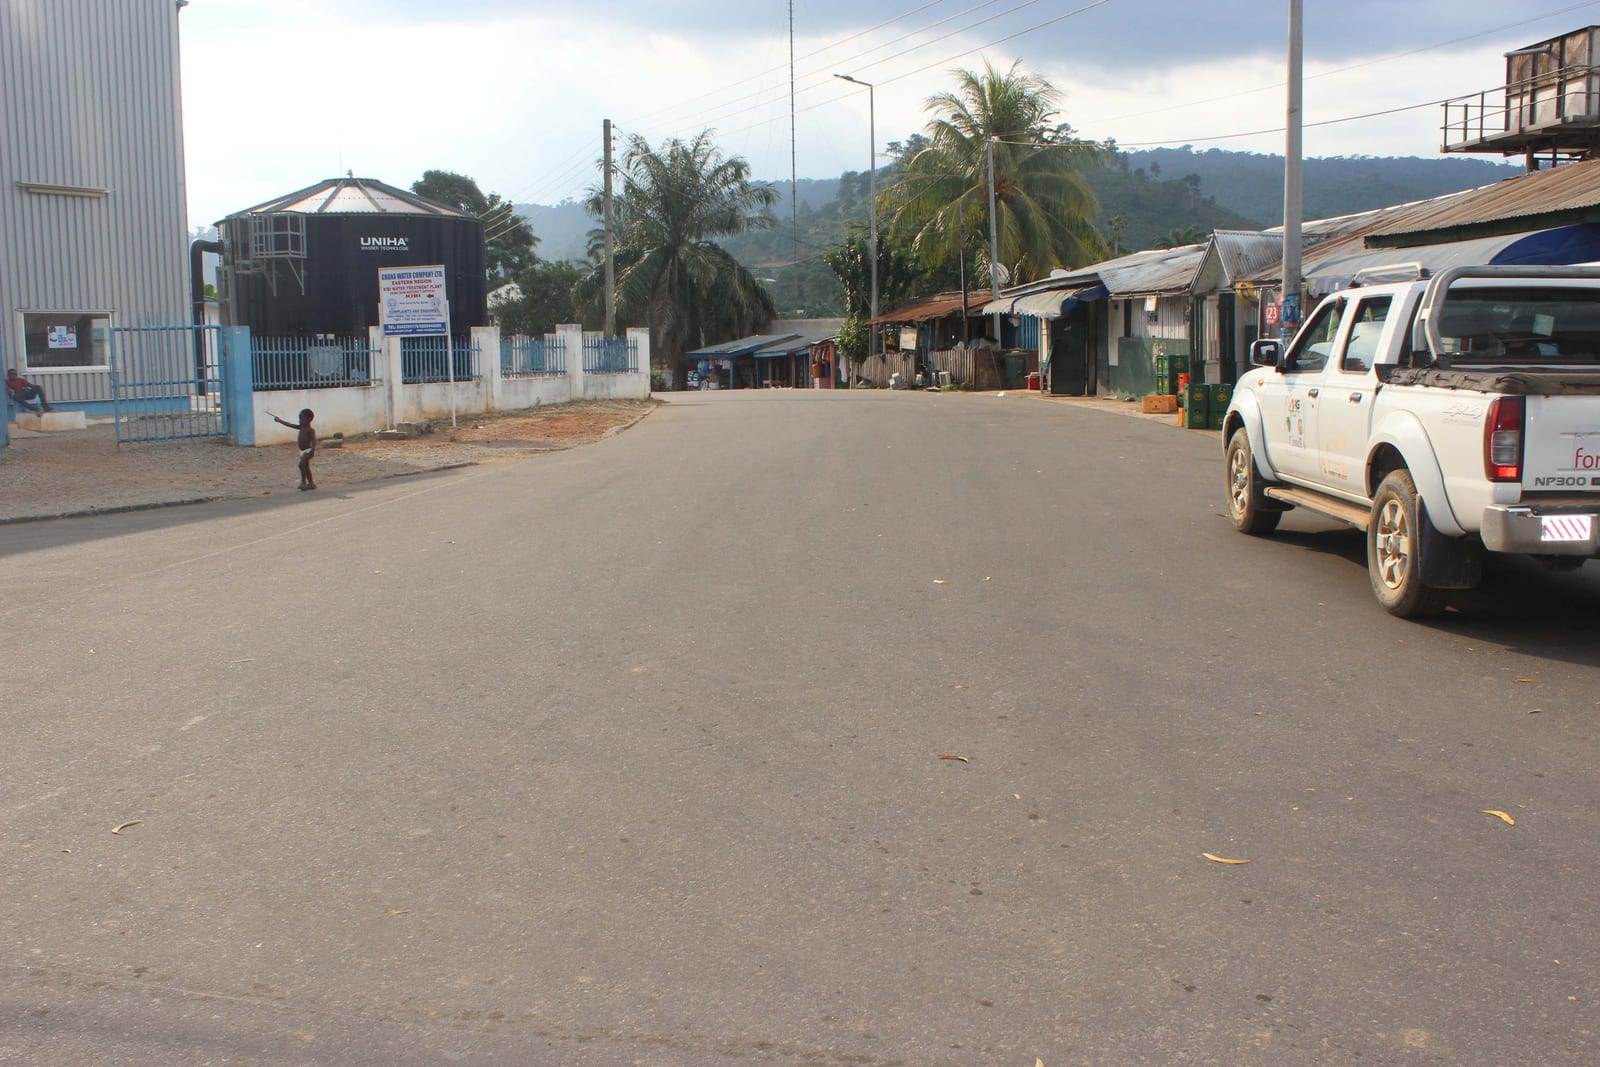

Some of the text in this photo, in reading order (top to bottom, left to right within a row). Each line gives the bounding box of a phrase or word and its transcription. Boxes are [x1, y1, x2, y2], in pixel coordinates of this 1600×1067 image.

[360, 237, 407, 246] UNIHA
[397, 272, 412, 280] WATER
[412, 271, 433, 279] COMPANY
[1535, 477, 1587, 486] NP300
